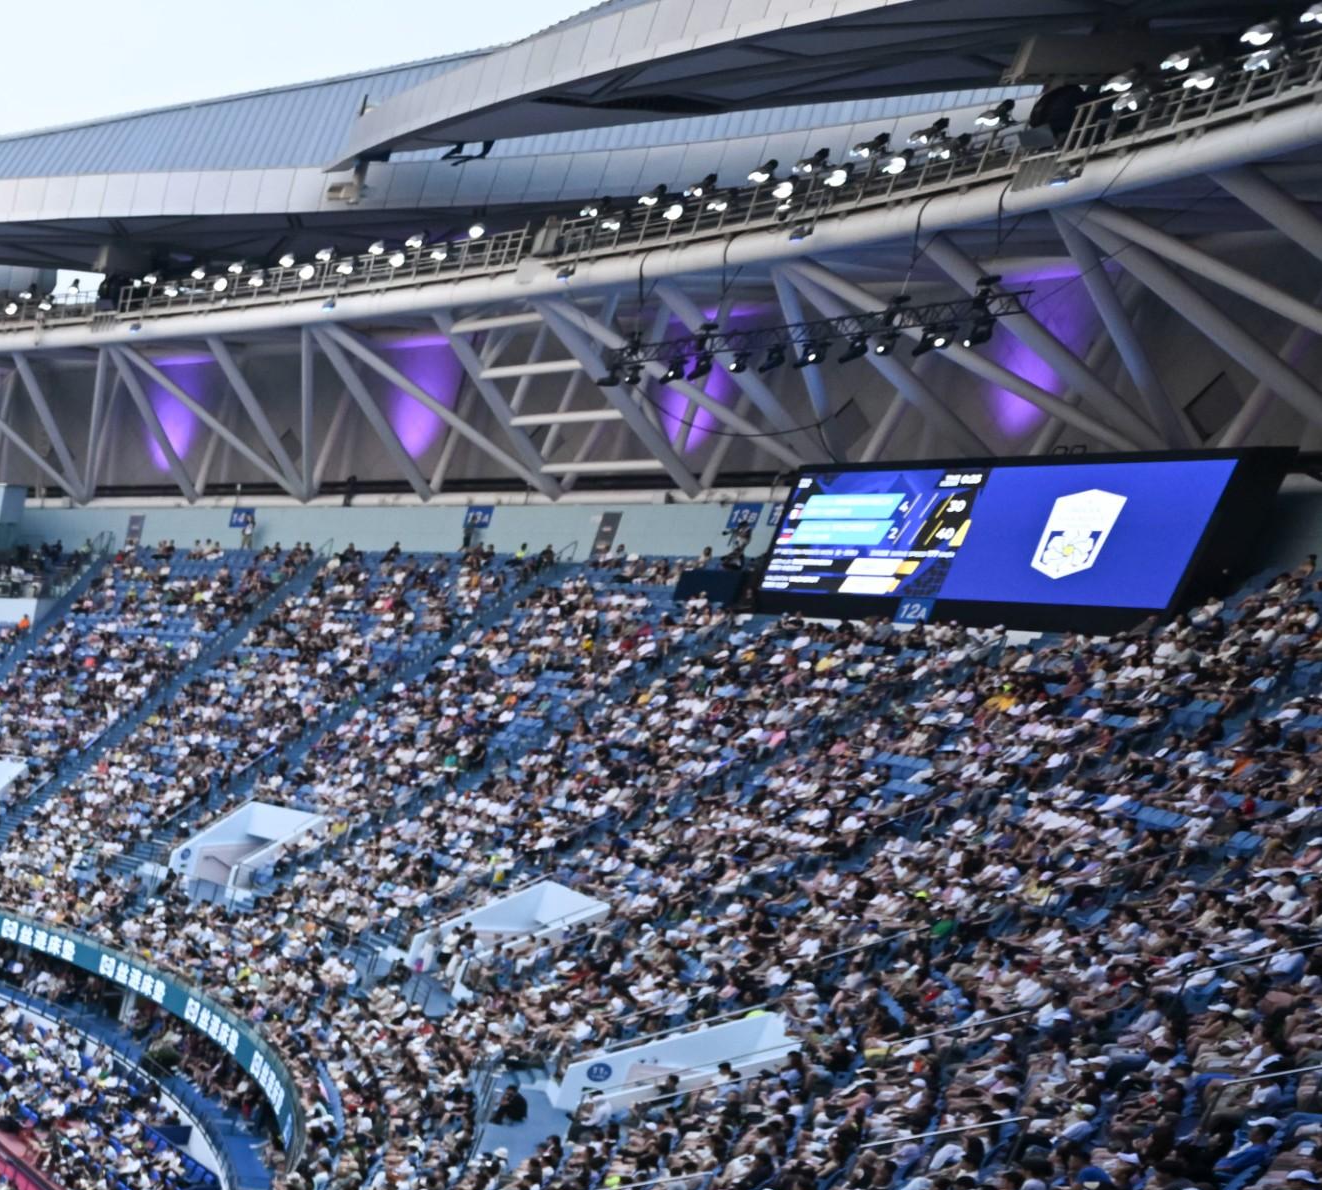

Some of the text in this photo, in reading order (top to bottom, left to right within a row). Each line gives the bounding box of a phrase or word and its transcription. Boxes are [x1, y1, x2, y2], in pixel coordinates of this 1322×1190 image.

[899, 501, 910, 512] 4
[947, 500, 967, 512] 30
[731, 508, 758, 522] 13B
[888, 528, 898, 539] 2
[935, 528, 955, 539] 40
[899, 603, 927, 619] 12A
